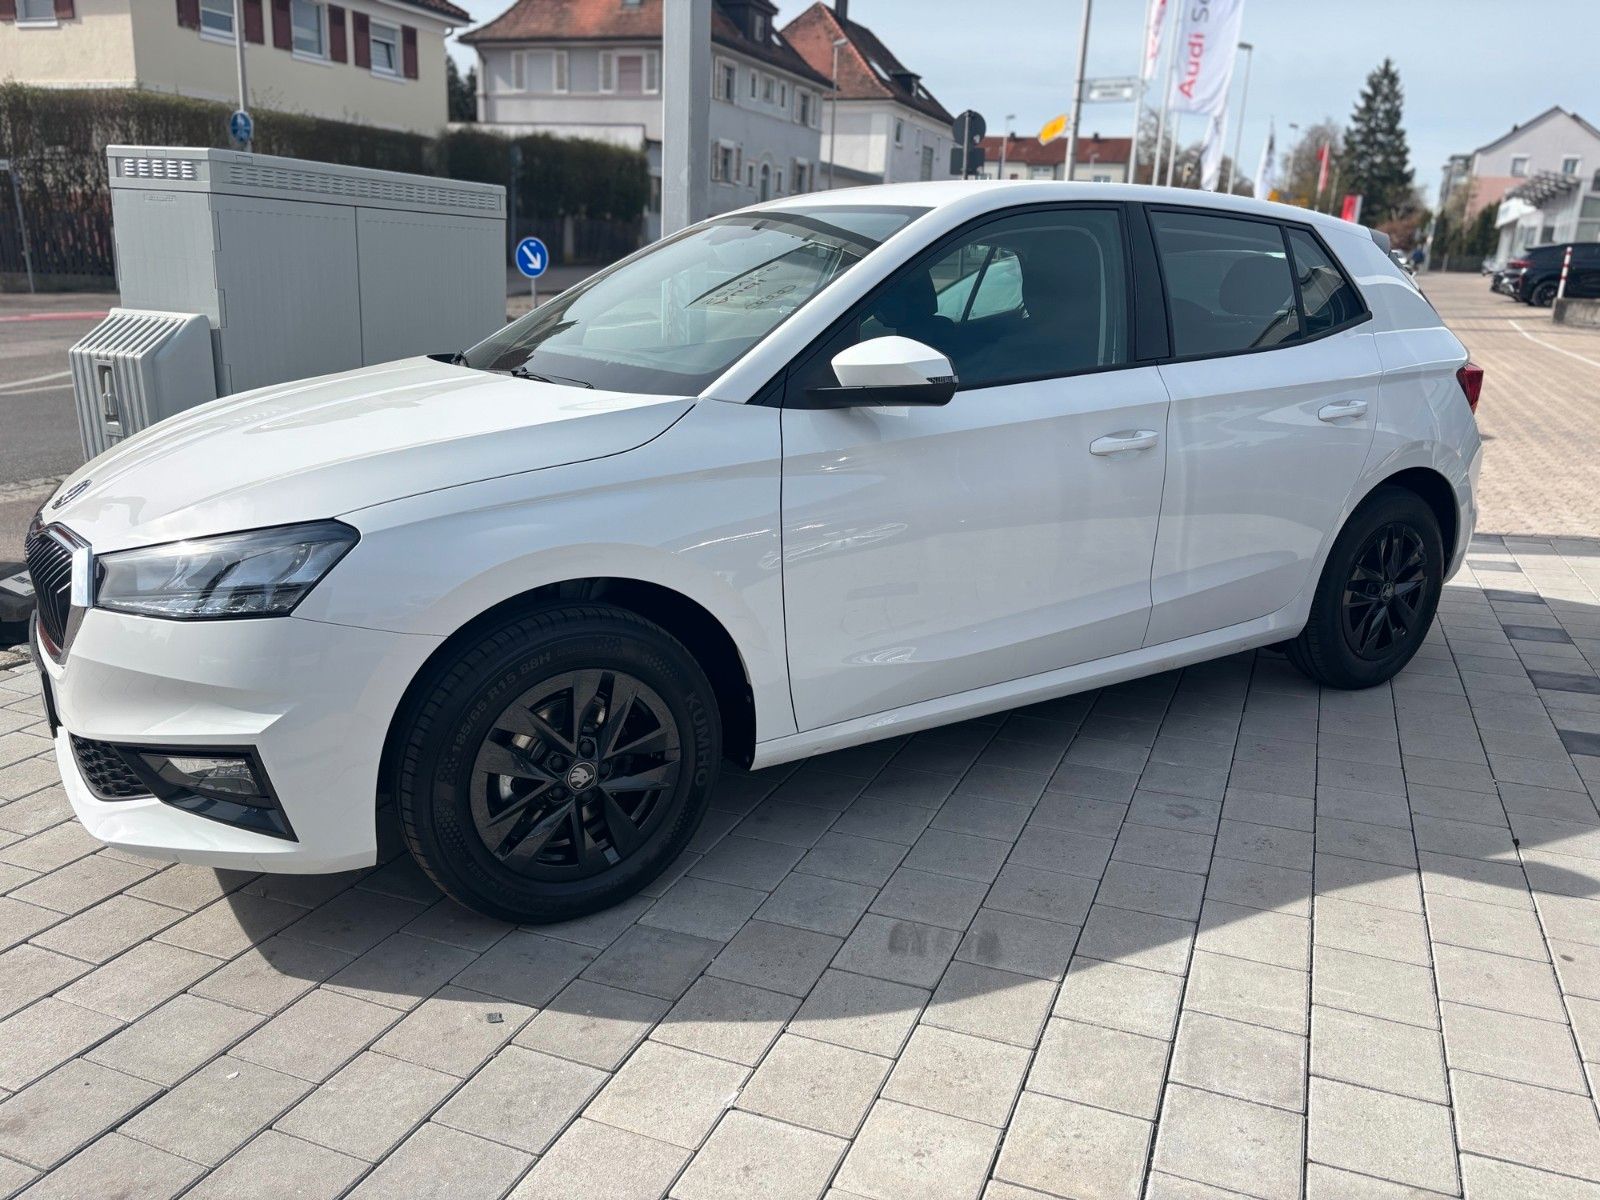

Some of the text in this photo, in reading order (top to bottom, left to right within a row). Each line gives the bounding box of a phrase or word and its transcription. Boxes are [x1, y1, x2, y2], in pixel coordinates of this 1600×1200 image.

[1179, 33, 1205, 98] Audi
[487, 671, 516, 700] R15
[684, 689, 711, 786] KUMHO
